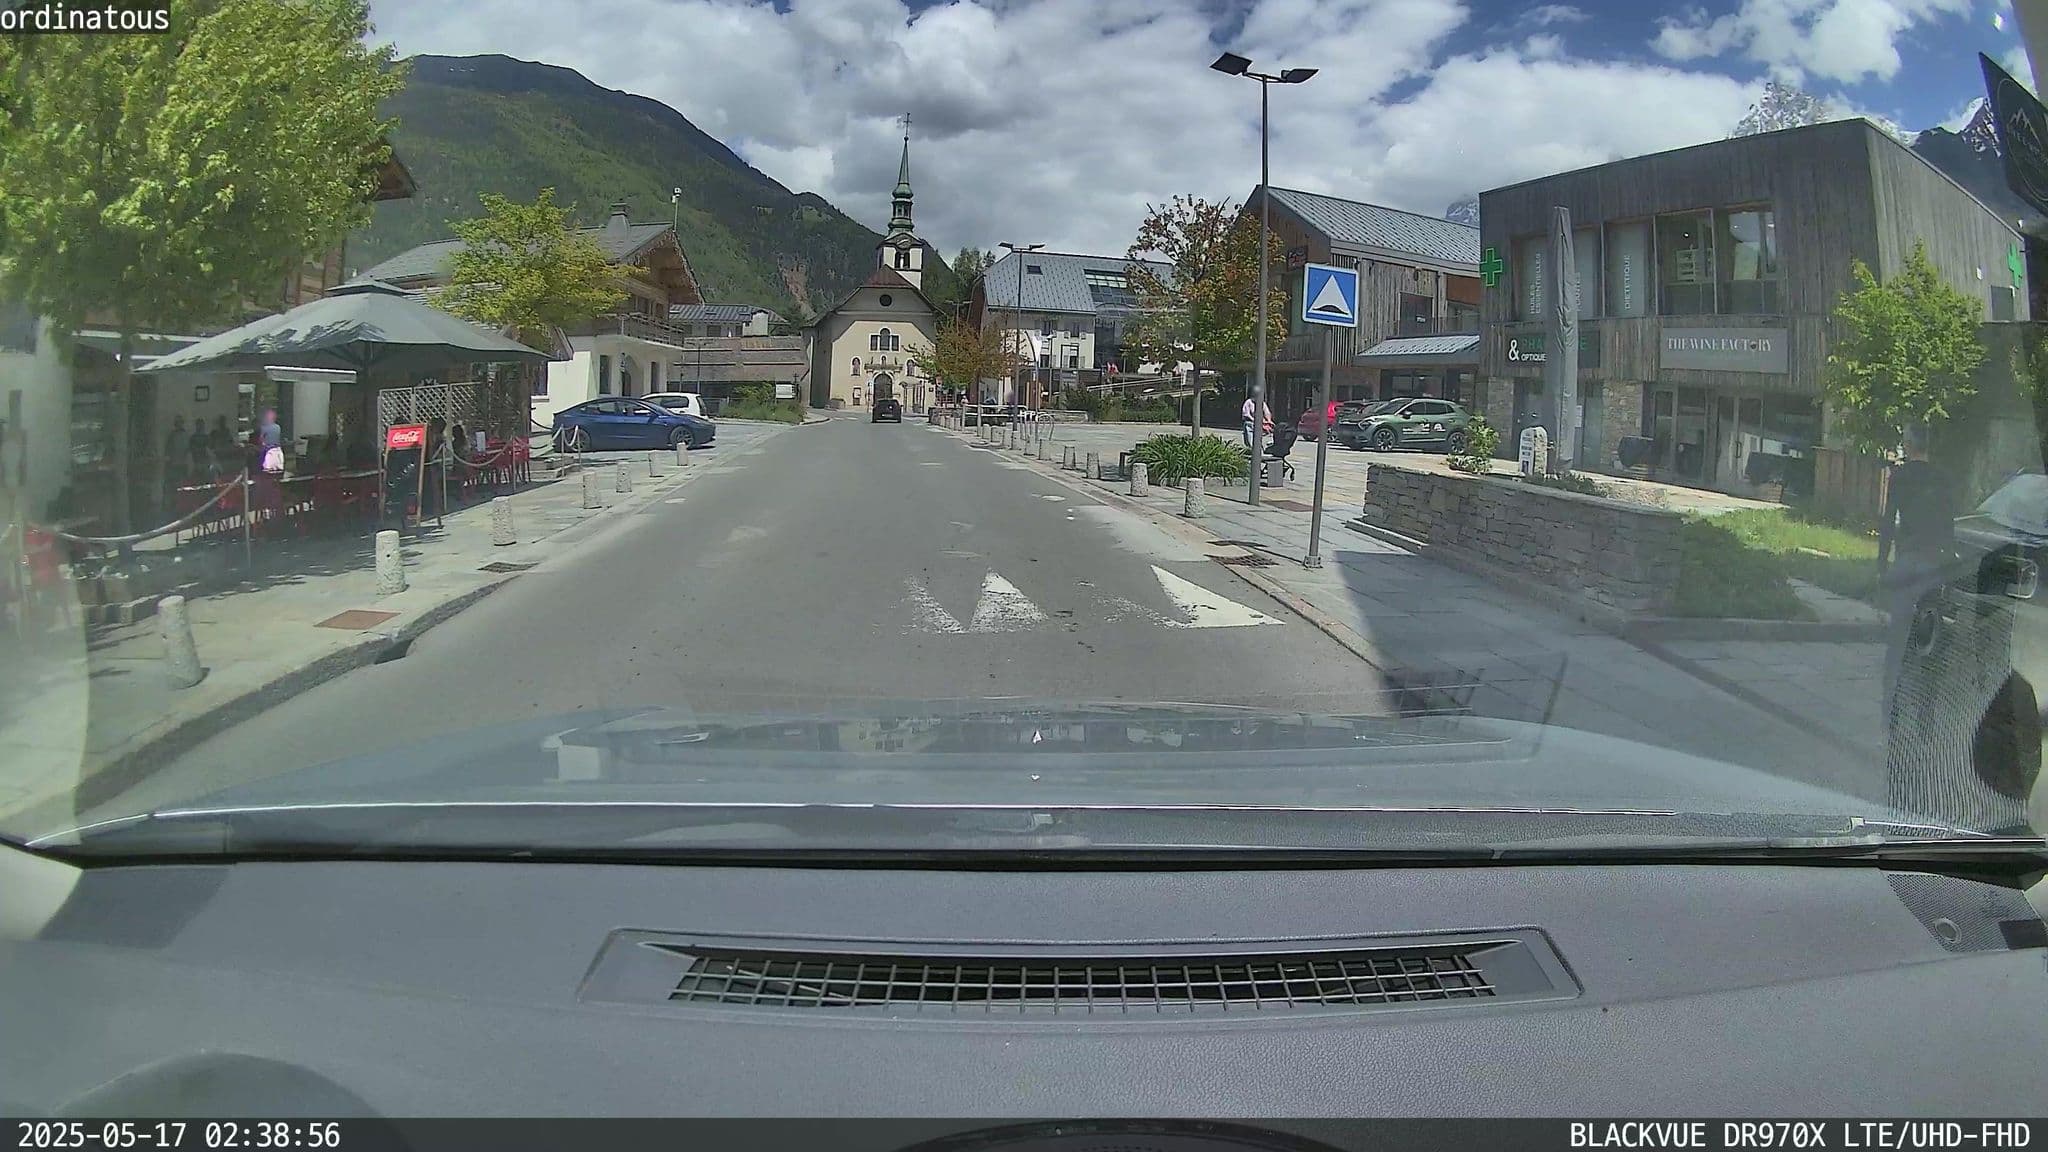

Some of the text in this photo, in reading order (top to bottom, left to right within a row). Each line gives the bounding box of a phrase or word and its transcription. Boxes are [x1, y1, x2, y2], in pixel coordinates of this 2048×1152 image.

[1508, 339, 1520, 361] &
[1521, 353, 1547, 361] OPTIQUE
[1668, 338, 1771, 351] THE WINE FACTORY
